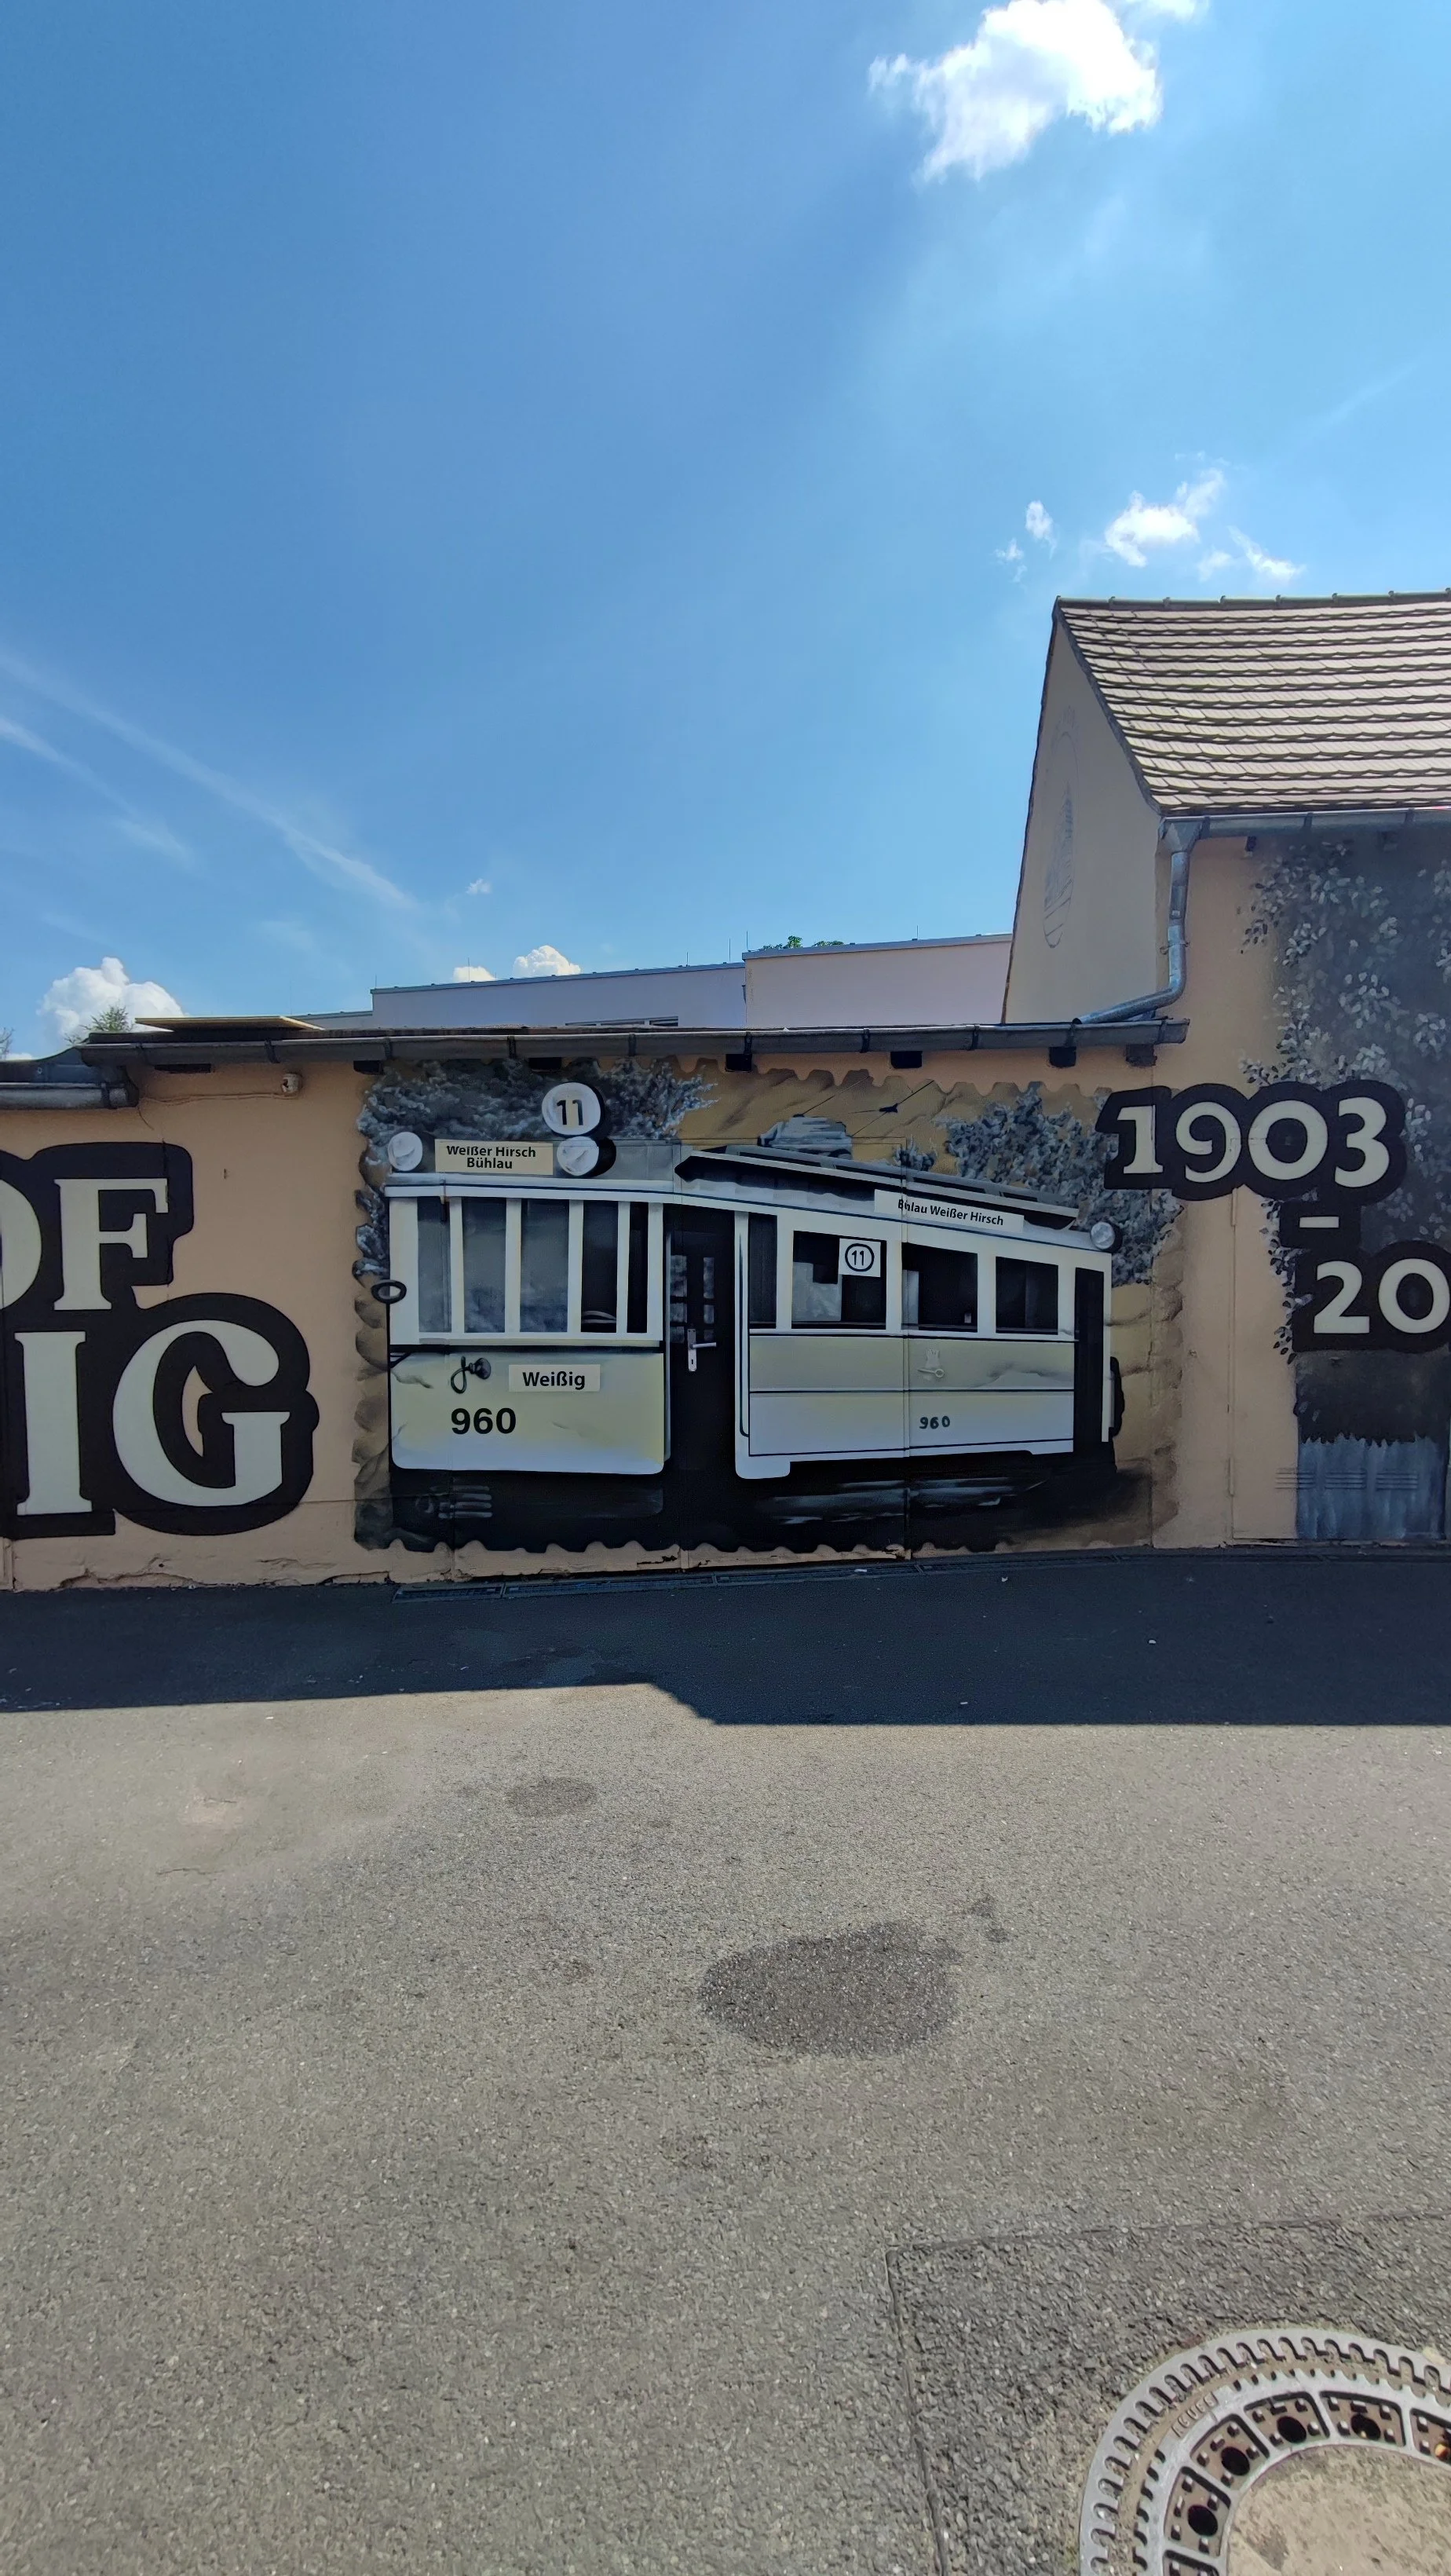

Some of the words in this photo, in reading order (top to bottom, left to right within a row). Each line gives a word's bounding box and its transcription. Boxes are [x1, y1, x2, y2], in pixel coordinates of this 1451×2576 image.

[556, 1099, 583, 1126] 11
[446, 1145, 493, 1156] Weißer
[495, 1146, 536, 1158] Hirsch
[1117, 1096, 1390, 1187] 1903
[466, 1157, 513, 1169] Bühlau
[930, 1206, 968, 1220] Weißer
[970, 1212, 1003, 1225] Hirsch
[851, 1250, 865, 1265] 11
[1313, 1258, 1450, 1334] 20
[522, 1370, 586, 1391] Weißig
[15, 1319, 291, 1516] IG
[451, 1407, 517, 1435] 960
[919, 1415, 951, 1429] 960
